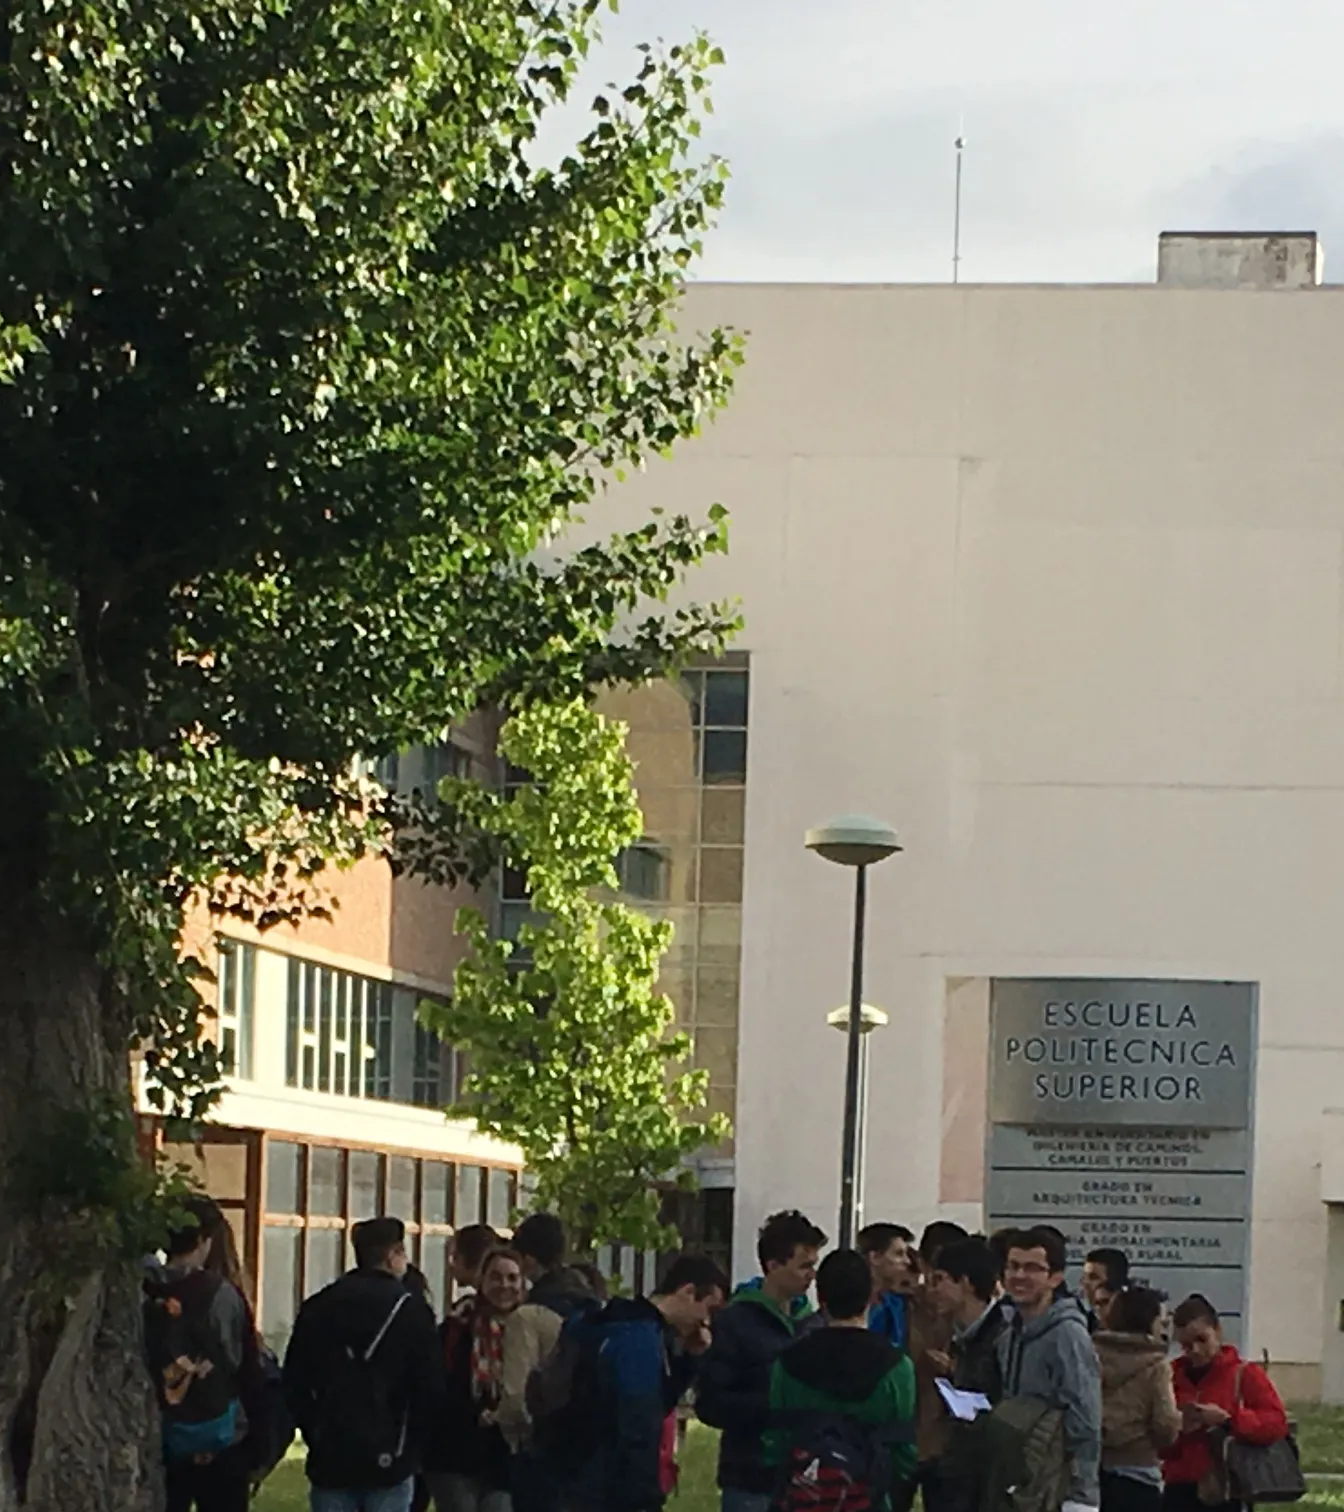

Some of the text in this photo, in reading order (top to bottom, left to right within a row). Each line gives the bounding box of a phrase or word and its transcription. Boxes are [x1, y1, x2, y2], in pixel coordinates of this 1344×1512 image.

[1044, 1001, 1197, 1028] ESCUELA
[1006, 1037, 1236, 1066] POLITECNICA
[1035, 1074, 1202, 1101] SUPERIOR
[1081, 1181, 1131, 1192] GRADO
